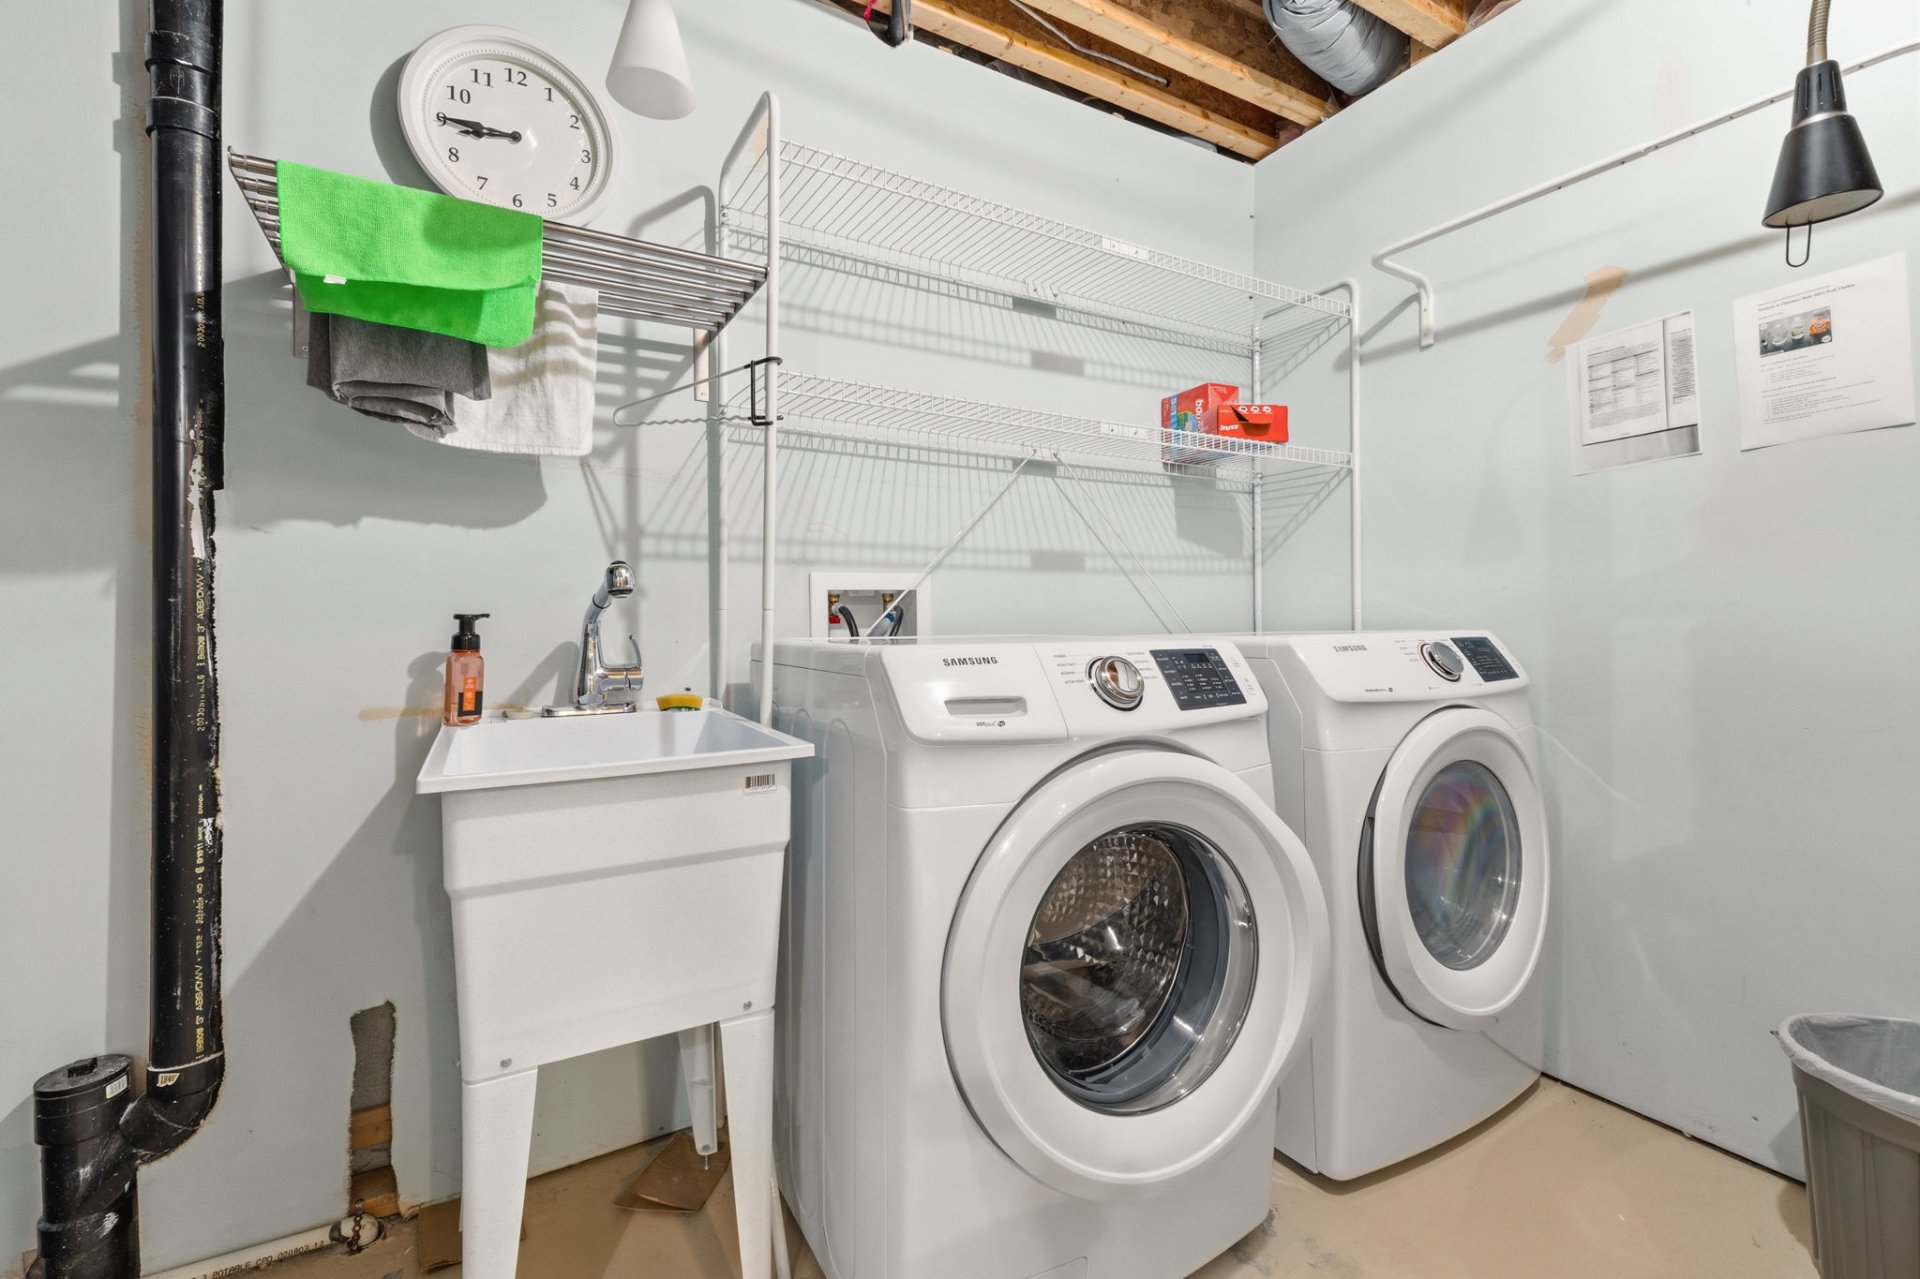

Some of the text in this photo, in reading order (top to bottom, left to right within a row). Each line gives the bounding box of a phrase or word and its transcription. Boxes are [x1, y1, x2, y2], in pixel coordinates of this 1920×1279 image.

[470, 68, 494, 88] 11
[504, 68, 528, 87] 12
[446, 85, 471, 104] 10
[544, 87, 554, 103] 1
[435, 111, 447, 127] 9
[569, 114, 580, 130] 2
[448, 147, 460, 163] 8
[580, 149, 591, 164] 3
[476, 175, 488, 191] 7
[569, 176, 580, 191] 4
[512, 194, 523, 208] 6
[547, 193, 557, 208] 5
[942, 656, 998, 667] SAMSUNG
[212, 1261, 252, 1279] POTABLE
